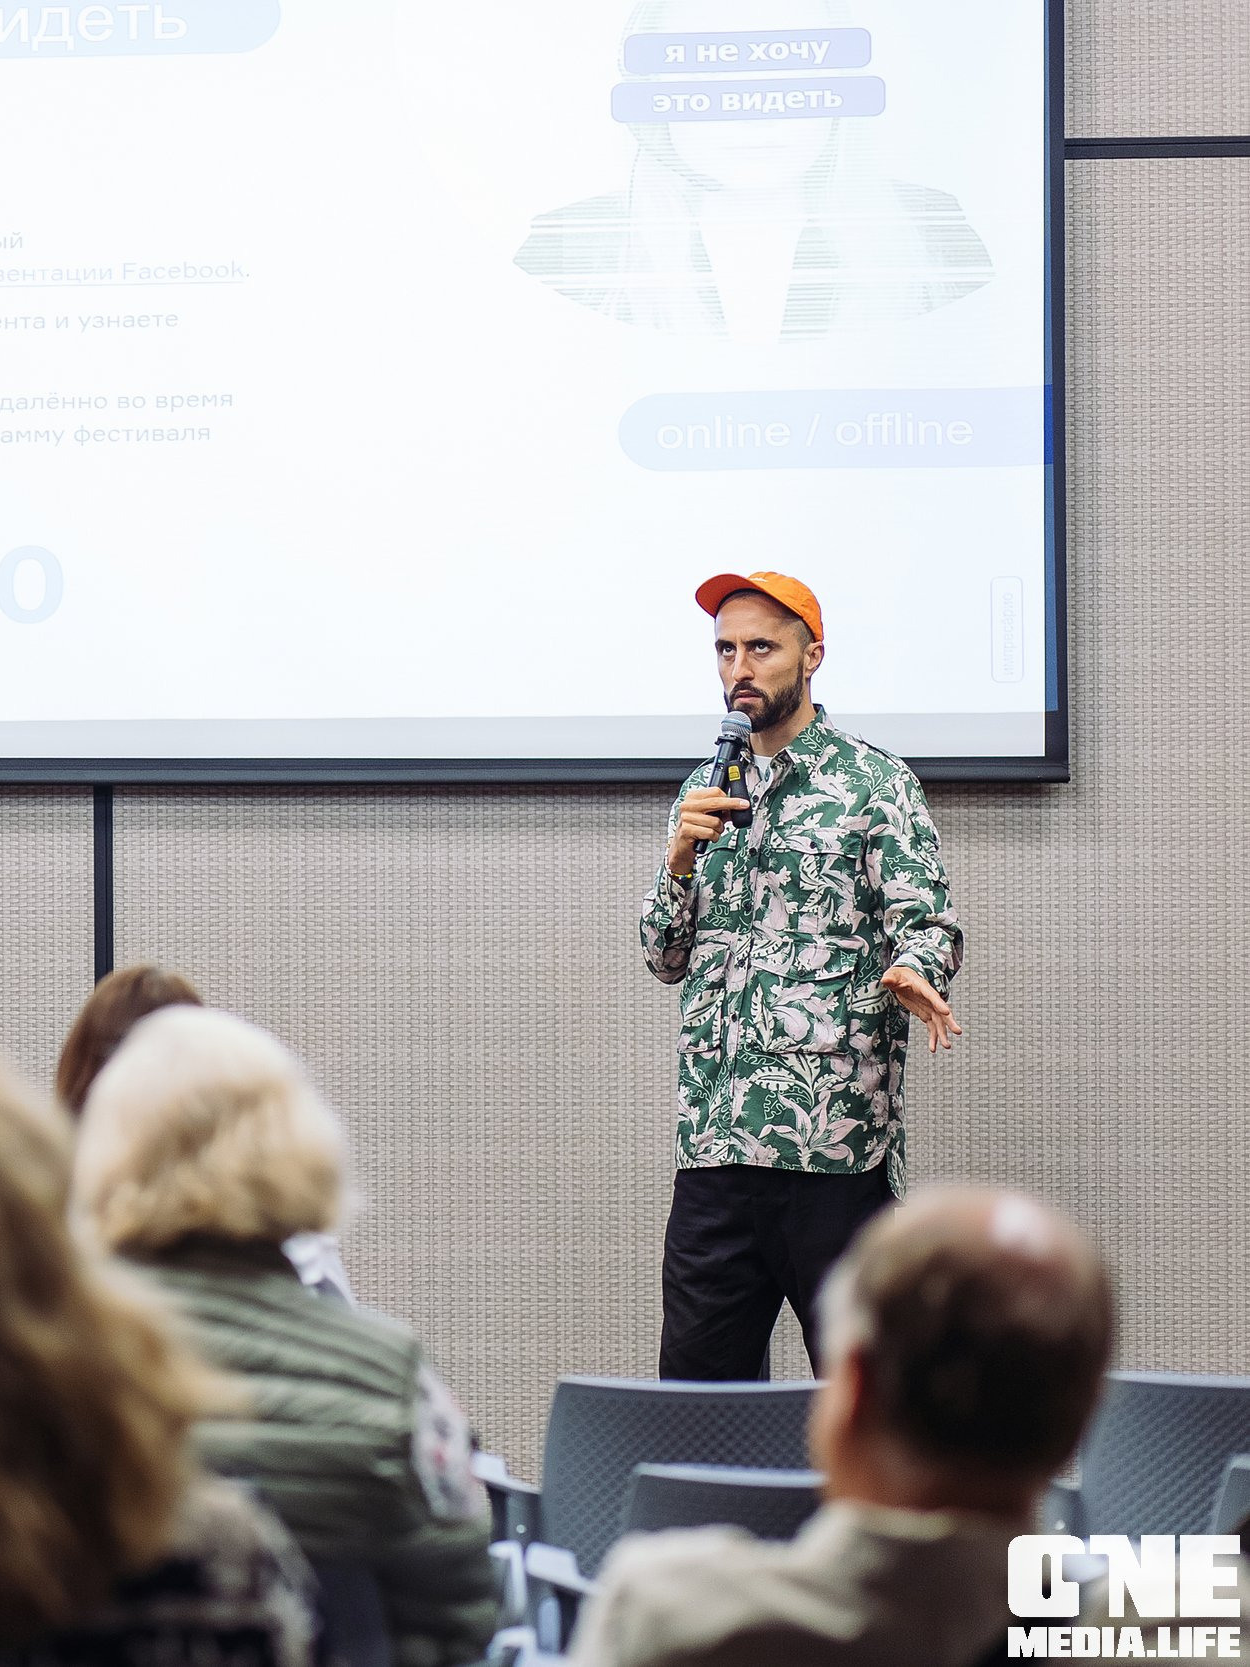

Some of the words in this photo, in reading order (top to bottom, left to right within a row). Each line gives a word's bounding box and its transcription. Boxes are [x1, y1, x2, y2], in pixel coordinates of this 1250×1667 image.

[663, 44, 685, 63] я
[696, 43, 739, 62] не
[749, 40, 831, 64] хочу
[652, 93, 710, 113] это
[721, 89, 844, 113] видеть
[122, 258, 251, 281] Facebook.
[54, 314, 69, 329] и
[77, 311, 179, 334] узнаете
[117, 394, 147, 409] во
[155, 392, 234, 413] время
[73, 424, 211, 446] фестиваля
[656, 414, 792, 450] online
[834, 411, 975, 447] offline
